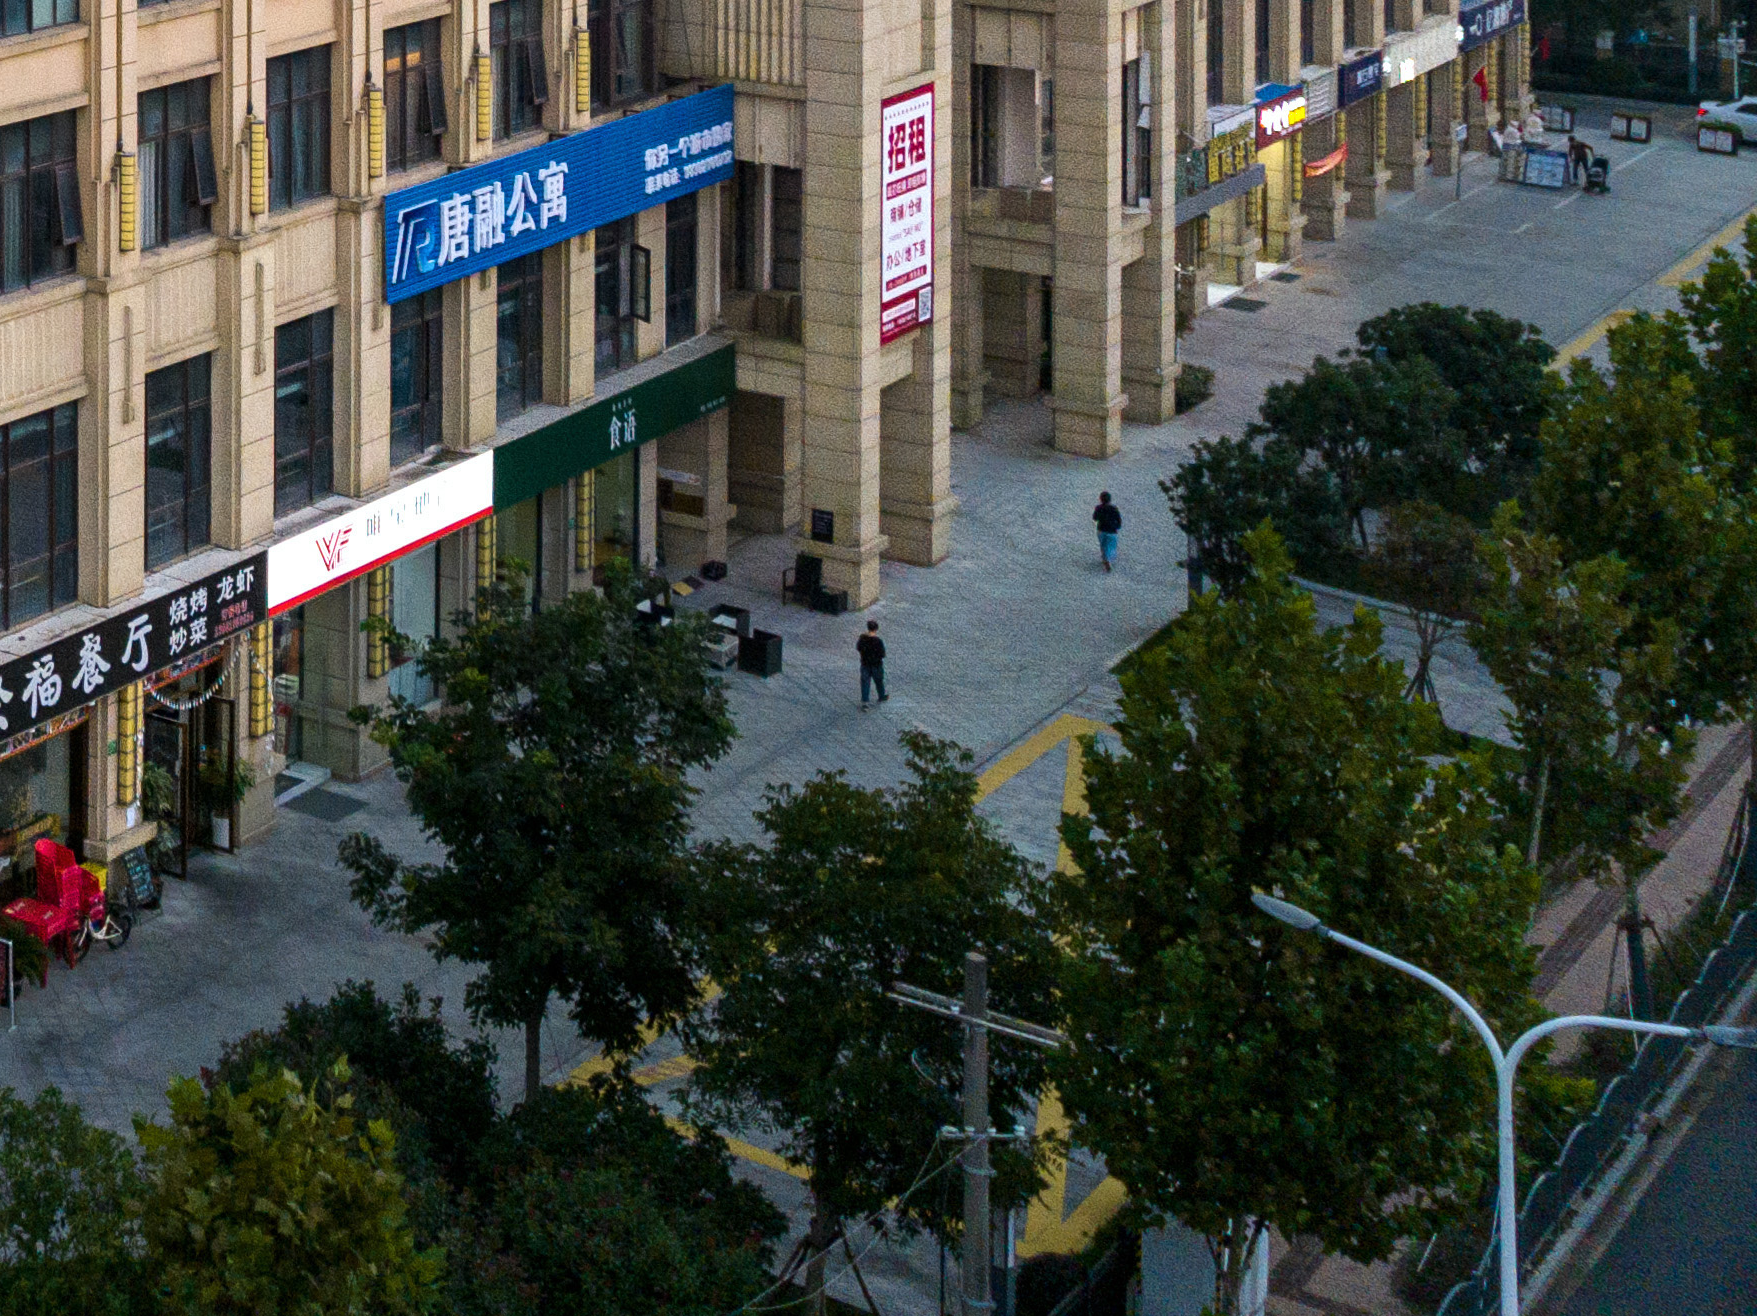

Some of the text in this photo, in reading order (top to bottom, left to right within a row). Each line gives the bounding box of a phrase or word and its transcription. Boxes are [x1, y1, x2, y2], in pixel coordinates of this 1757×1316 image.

[887, 115, 926, 175] 招租
[438, 160, 569, 267] 唐融公寓
[169, 587, 208, 627] 烧烤
[216, 566, 255, 605] 龙虾
[169, 617, 208, 657] 炒菜
